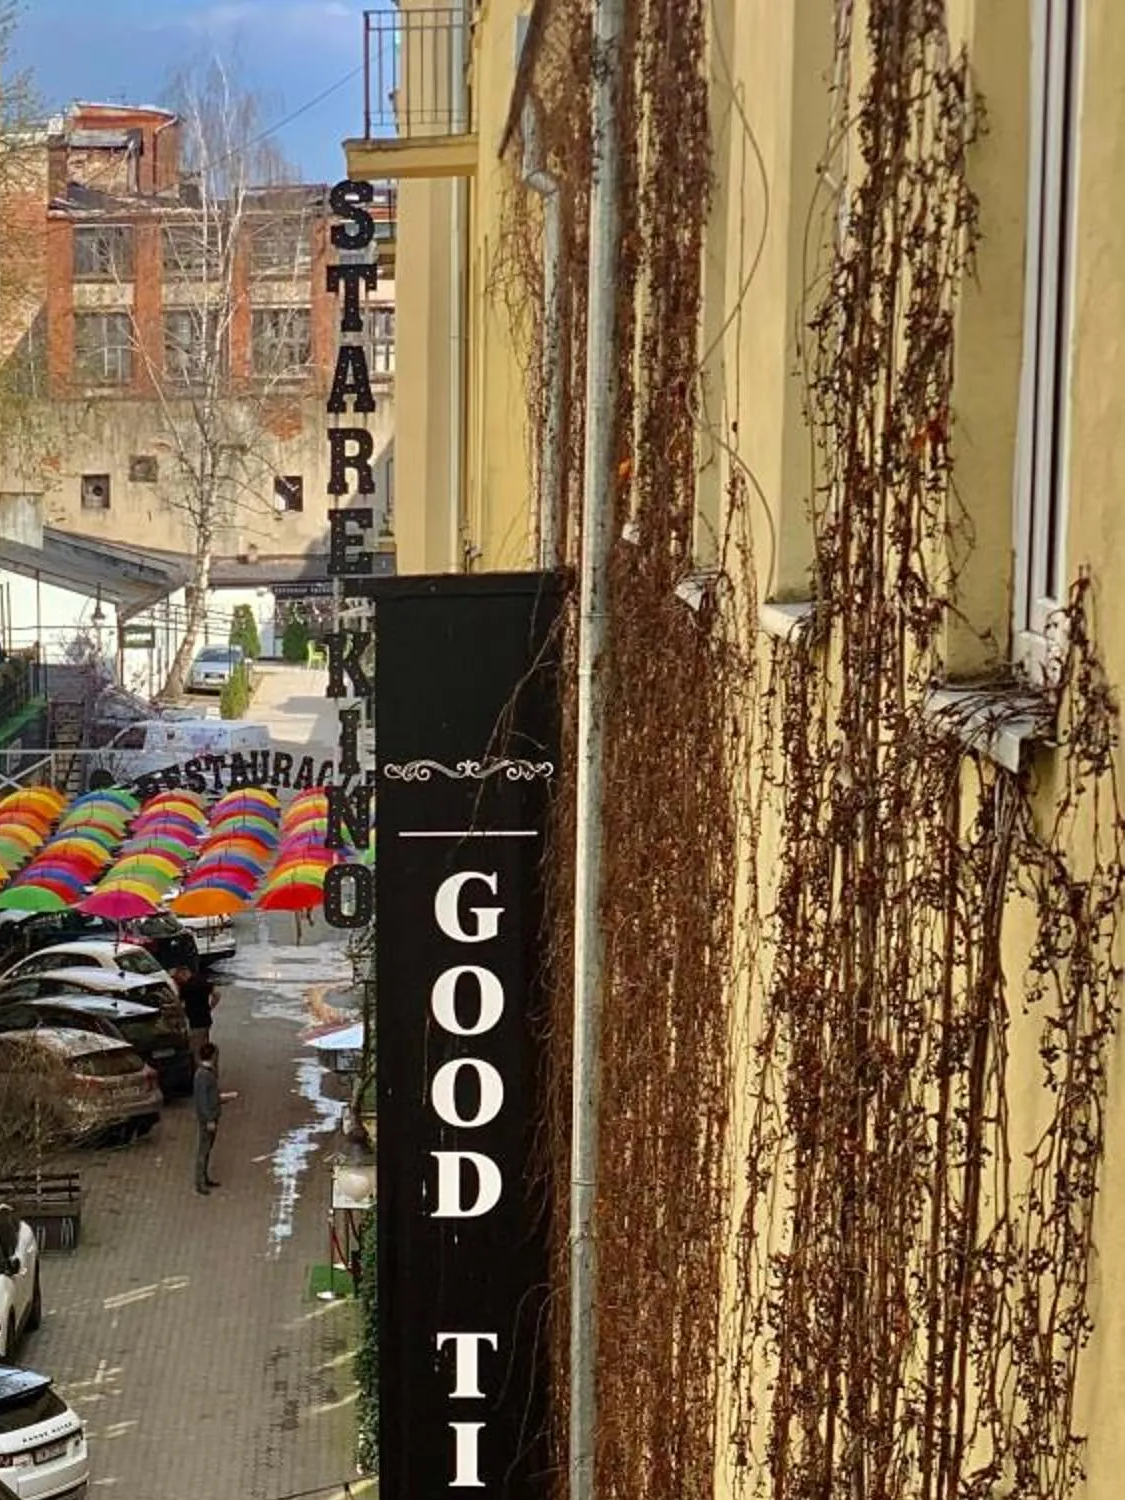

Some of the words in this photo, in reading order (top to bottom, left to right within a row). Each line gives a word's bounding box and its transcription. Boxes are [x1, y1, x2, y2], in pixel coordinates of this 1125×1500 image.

[326, 179, 377, 575] STARE
[324, 631, 375, 929] KINO
[430, 870, 505, 1220] GOOD
